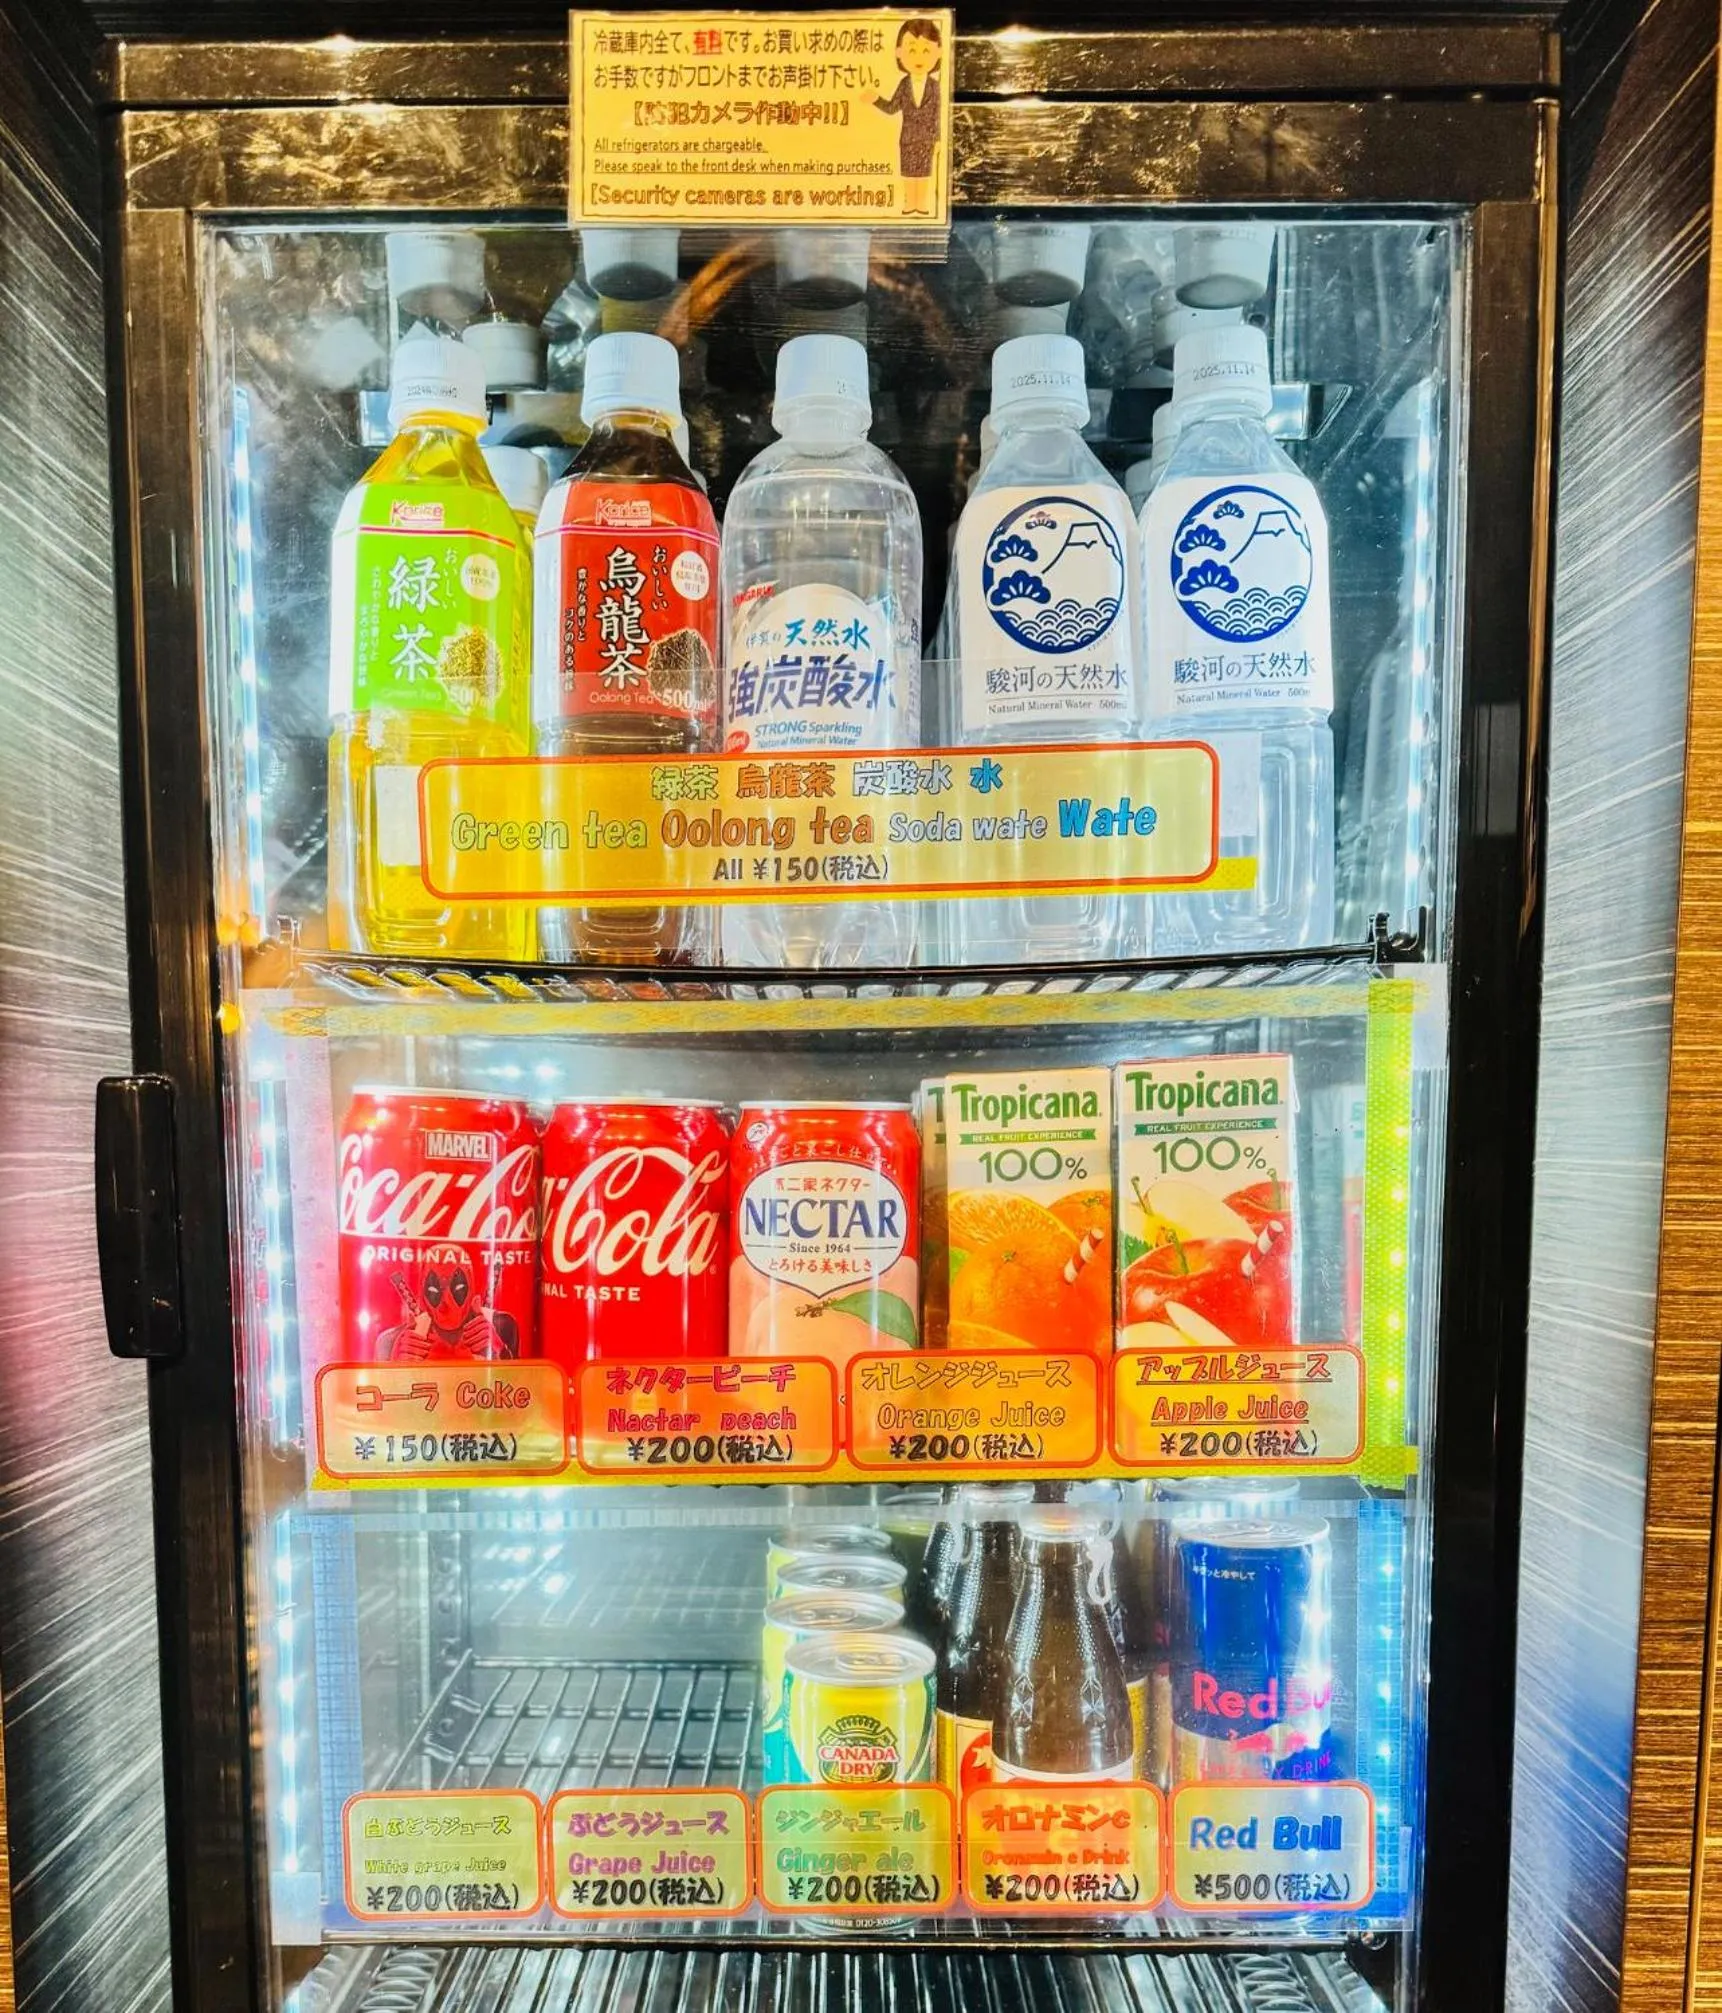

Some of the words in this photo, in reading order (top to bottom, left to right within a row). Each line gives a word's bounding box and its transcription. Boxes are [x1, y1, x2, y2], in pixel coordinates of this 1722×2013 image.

[594, 138, 610, 152] All
[612, 138, 680, 153] refrigerators
[682, 140, 699, 151] are
[594, 159, 629, 173] Please
[632, 160, 663, 174] speak
[666, 160, 677, 172] to
[680, 159, 699, 172] the
[701, 159, 730, 172] front
[732, 159, 757, 172] desk
[760, 159, 790, 172] when
[793, 158, 834, 174] making
[685, 185, 766, 205] cameras
[772, 187, 804, 205] are
[652, 546, 668, 610] おいしい
[388, 554, 440, 683] 緑茶
[595, 546, 649, 690] 烏龍茶
[986, 664, 1128, 695] 駿河の天然水
[1174, 651, 1316, 685] 駿河の天然水
[590, 691, 632, 705] Oolong
[634, 691, 655, 705] Tea
[988, 701, 1024, 715] Natural
[1027, 699, 1064, 713] Mineral
[1065, 699, 1093, 711] Water
[1176, 692, 1214, 706] Natural
[1216, 689, 1251, 702] Mineral
[1254, 687, 1282, 699] Water
[755, 720, 807, 737] STRONG
[809, 720, 863, 736] Sparkling
[828, 733, 858, 746] Water
[651, 765, 719, 801] 緑茶
[736, 762, 836, 799] 烏龍茶
[852, 759, 951, 796] 炭酸水
[969, 757, 1003, 794] 水
[451, 812, 570, 852] Green
[582, 810, 648, 849] tea
[660, 808, 795, 851] Oolong
[810, 806, 874, 845] tea
[888, 811, 963, 843] Soda
[972, 809, 1048, 841] wate
[1058, 797, 1156, 838] Wate
[713, 858, 744, 881] All
[951, 1083, 1099, 1128] Tropicana
[1126, 1070, 1280, 1117] Tropicana
[972, 1134, 995, 1145] REAL
[998, 1132, 1024, 1143] FRUIT
[1027, 1130, 1083, 1143] EXPERIENCE
[1147, 1123, 1171, 1133] REAL
[1174, 1121, 1201, 1132] FRUIT
[1204, 1118, 1264, 1131] EXPERIENCE
[428, 1133, 490, 1159] MARVEL
[1153, 1136, 1267, 1174] 100%
[978, 1147, 1087, 1183] 100%
[744, 1197, 900, 1239] NECTAR
[363, 1246, 472, 1264] ORIGINAL
[480, 1249, 531, 1265] TASTE
[789, 1242, 820, 1254] Since
[825, 1242, 850, 1254] 1964
[768, 1258, 872, 1274] とろける美味しさ
[574, 1284, 641, 1301] TASTE
[606, 1364, 797, 1394] ネクターピーチ
[861, 1360, 1072, 1390] オレンジジュース
[1137, 1353, 1332, 1382] アップルジュース
[356, 1382, 440, 1411] コーラ
[456, 1380, 531, 1409] Coke
[1151, 1395, 1228, 1424] Apple
[1238, 1394, 1309, 1420] Juice
[608, 1408, 701, 1432] Nactar
[877, 1402, 981, 1430] Orange
[990, 1401, 1066, 1427] Juice
[627, 1434, 793, 1464] ¥200(税込)
[889, 1433, 1044, 1460] ¥200(税込)
[1160, 1429, 1318, 1457] ¥200(税込)
[1192, 1671, 1279, 1720] Red
[819, 1745, 897, 1761] CANADA
[840, 1760, 876, 1777] DRY
[568, 1811, 730, 1838] ぶどうジュース
[775, 1809, 927, 1833] ジンジャエール
[1189, 1815, 1259, 1851] Red
[1273, 1815, 1343, 1851] Bull
[364, 1859, 409, 1874] White
[465, 1857, 508, 1872] Juice
[568, 1852, 643, 1877] Grape
[652, 1850, 717, 1875] Juice
[776, 1847, 868, 1876] Ginger
[875, 1846, 915, 1872] ale
[1082, 1848, 1131, 1865] Drink
[366, 1883, 520, 1912] ¥200(税込)
[572, 1877, 724, 1906] ¥200(税込)
[788, 1874, 940, 1904] ¥200(税込)
[984, 1873, 1139, 1903] ¥200(税込)
[1194, 1872, 1351, 1902] ¥500(税込)
